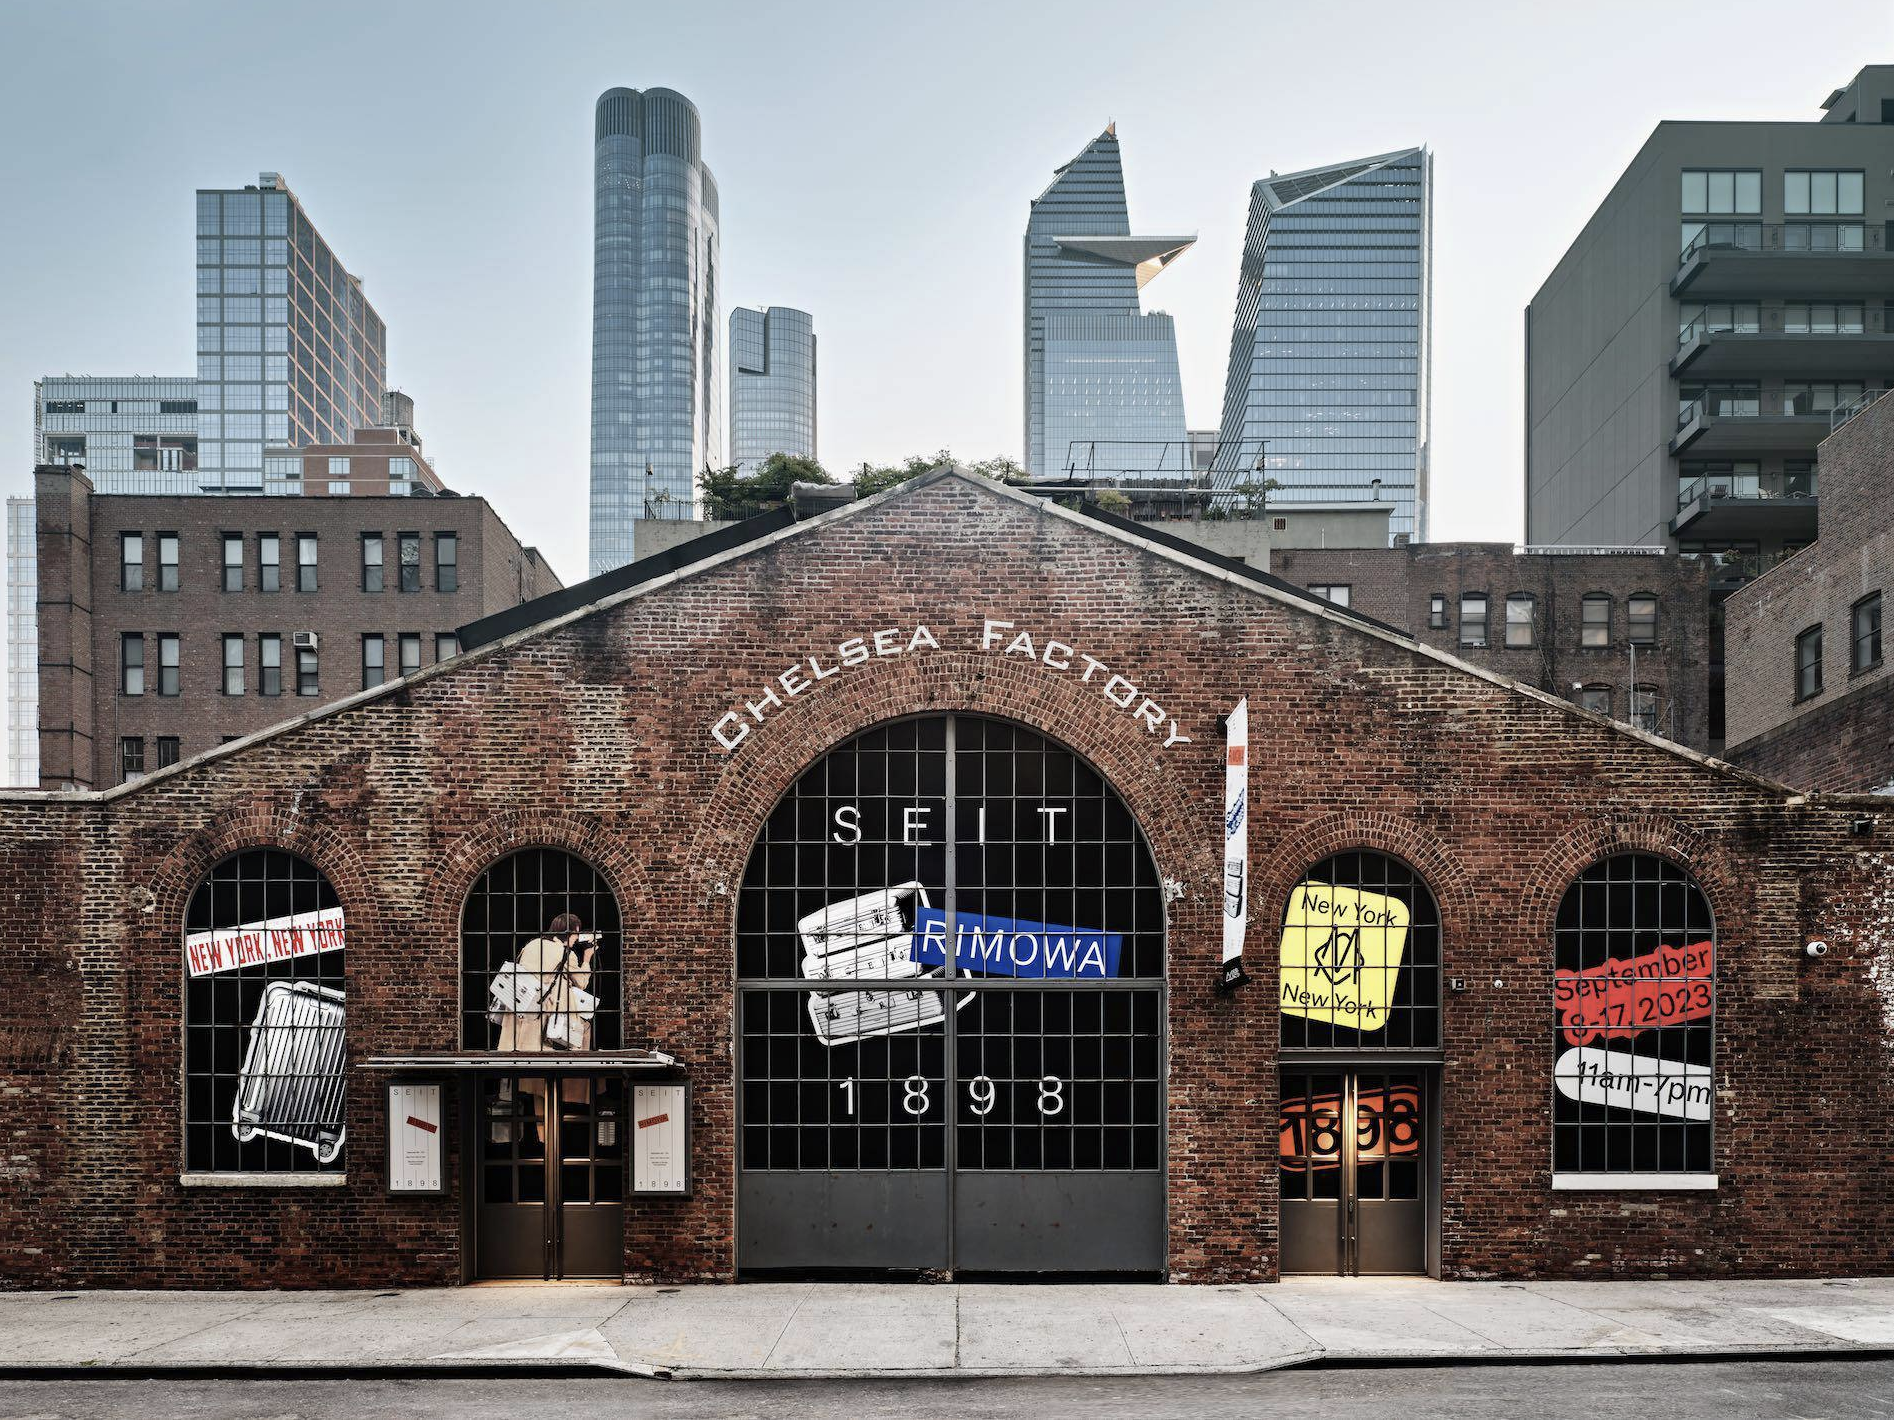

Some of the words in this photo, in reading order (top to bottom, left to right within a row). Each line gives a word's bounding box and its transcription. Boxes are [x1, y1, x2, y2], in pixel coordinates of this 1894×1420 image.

[711, 625, 940, 750] CHELSEA
[982, 619, 1193, 748] FACTORY
[833, 806, 1067, 846] SEIT
[1301, 893, 1347, 918] New
[1353, 901, 1397, 929] York
[189, 940, 223, 973] NEW
[271, 924, 305, 957] NEW
[307, 917, 345, 950] YORK
[922, 919, 1106, 976] RIMOWA
[1556, 948, 1709, 1002] September
[1283, 982, 1328, 1009] New
[1335, 992, 1377, 1019] York
[1638, 984, 1711, 1023] 2023
[838, 1075, 1064, 1115] 1898
[1577, 1061, 1710, 1105] 11am-7pm
[1280, 1099, 1419, 1157] 1898
